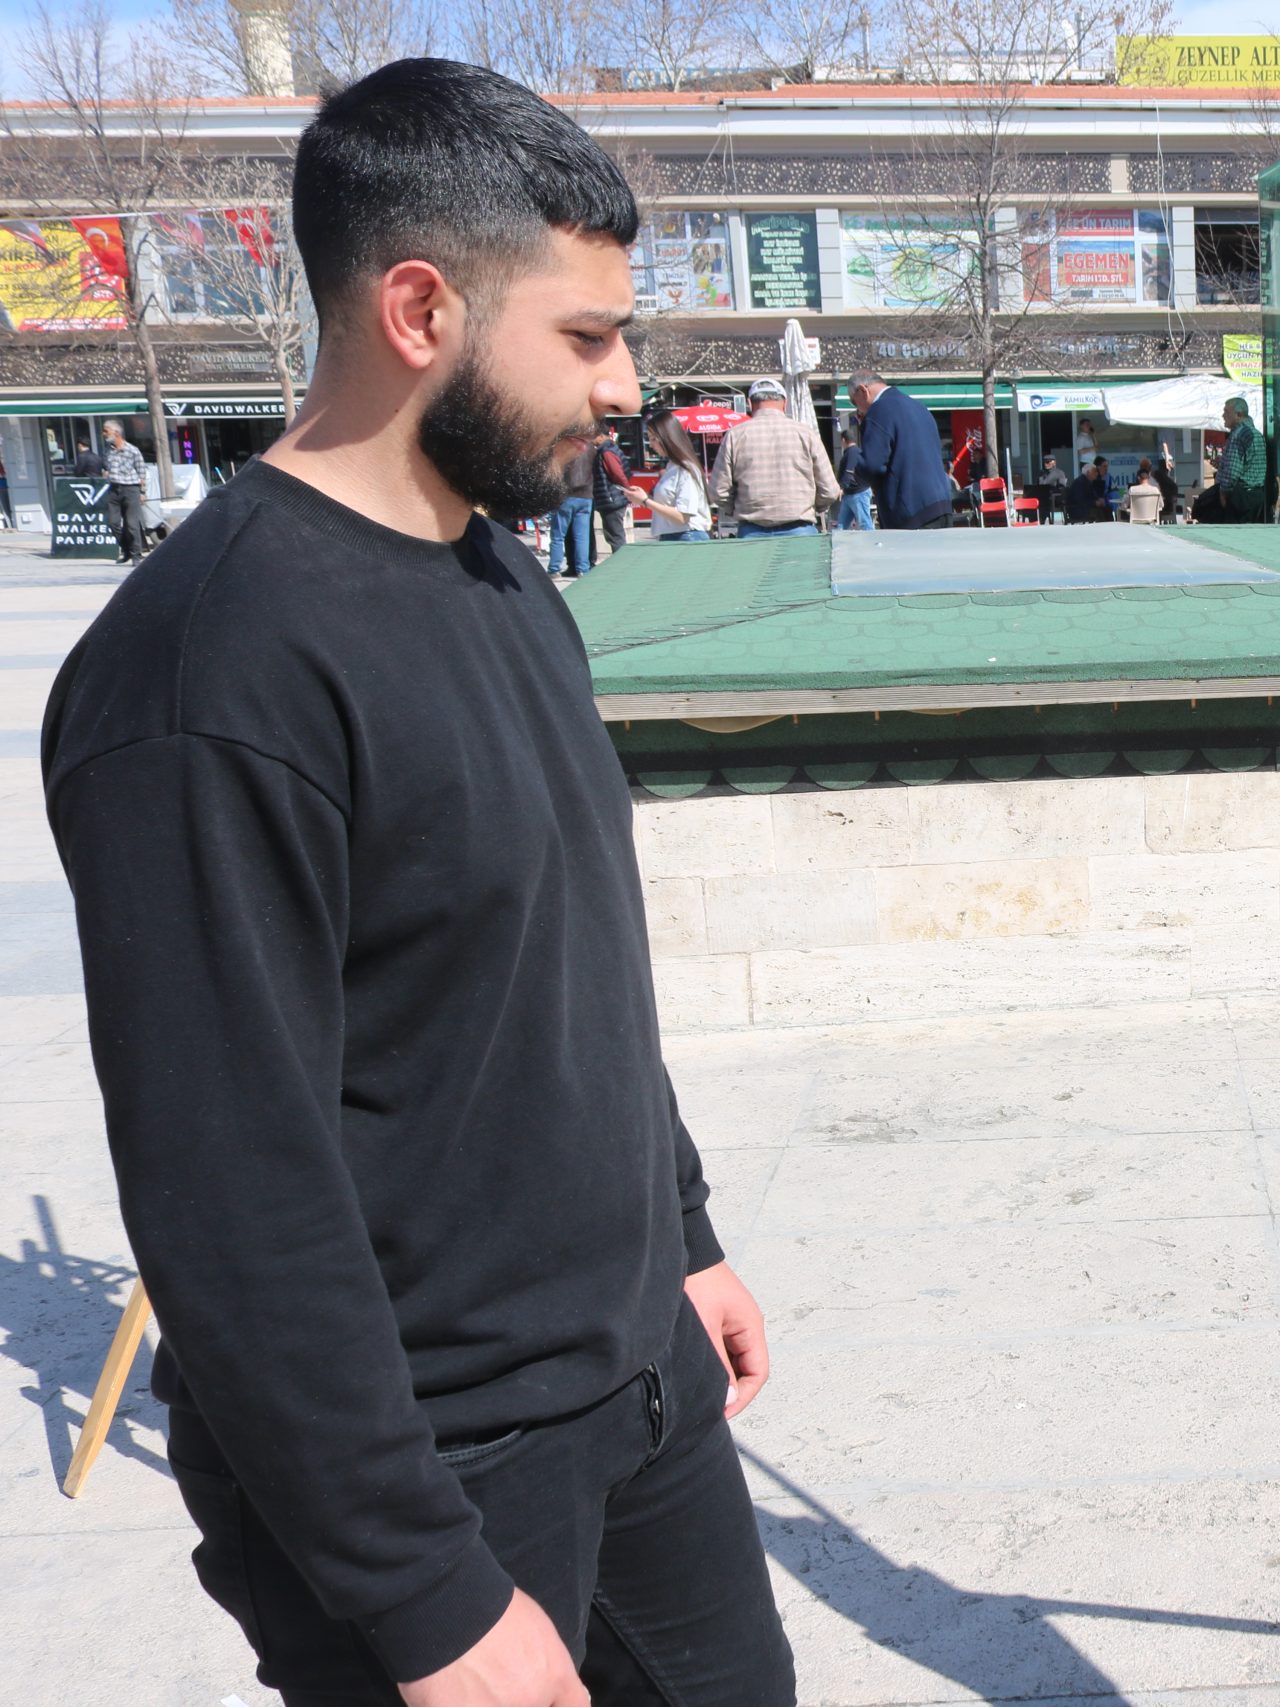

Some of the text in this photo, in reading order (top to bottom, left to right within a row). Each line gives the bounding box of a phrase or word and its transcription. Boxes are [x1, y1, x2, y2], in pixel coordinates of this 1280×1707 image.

[1176, 46, 1240, 67] ZEYNEP
[1100, 218, 1131, 230] TARIM
[1063, 252, 1129, 270] EGEMEN
[194, 405, 233, 414] DAVID
[234, 405, 286, 414] WALKER
[56, 534, 117, 545] PARFÜM
